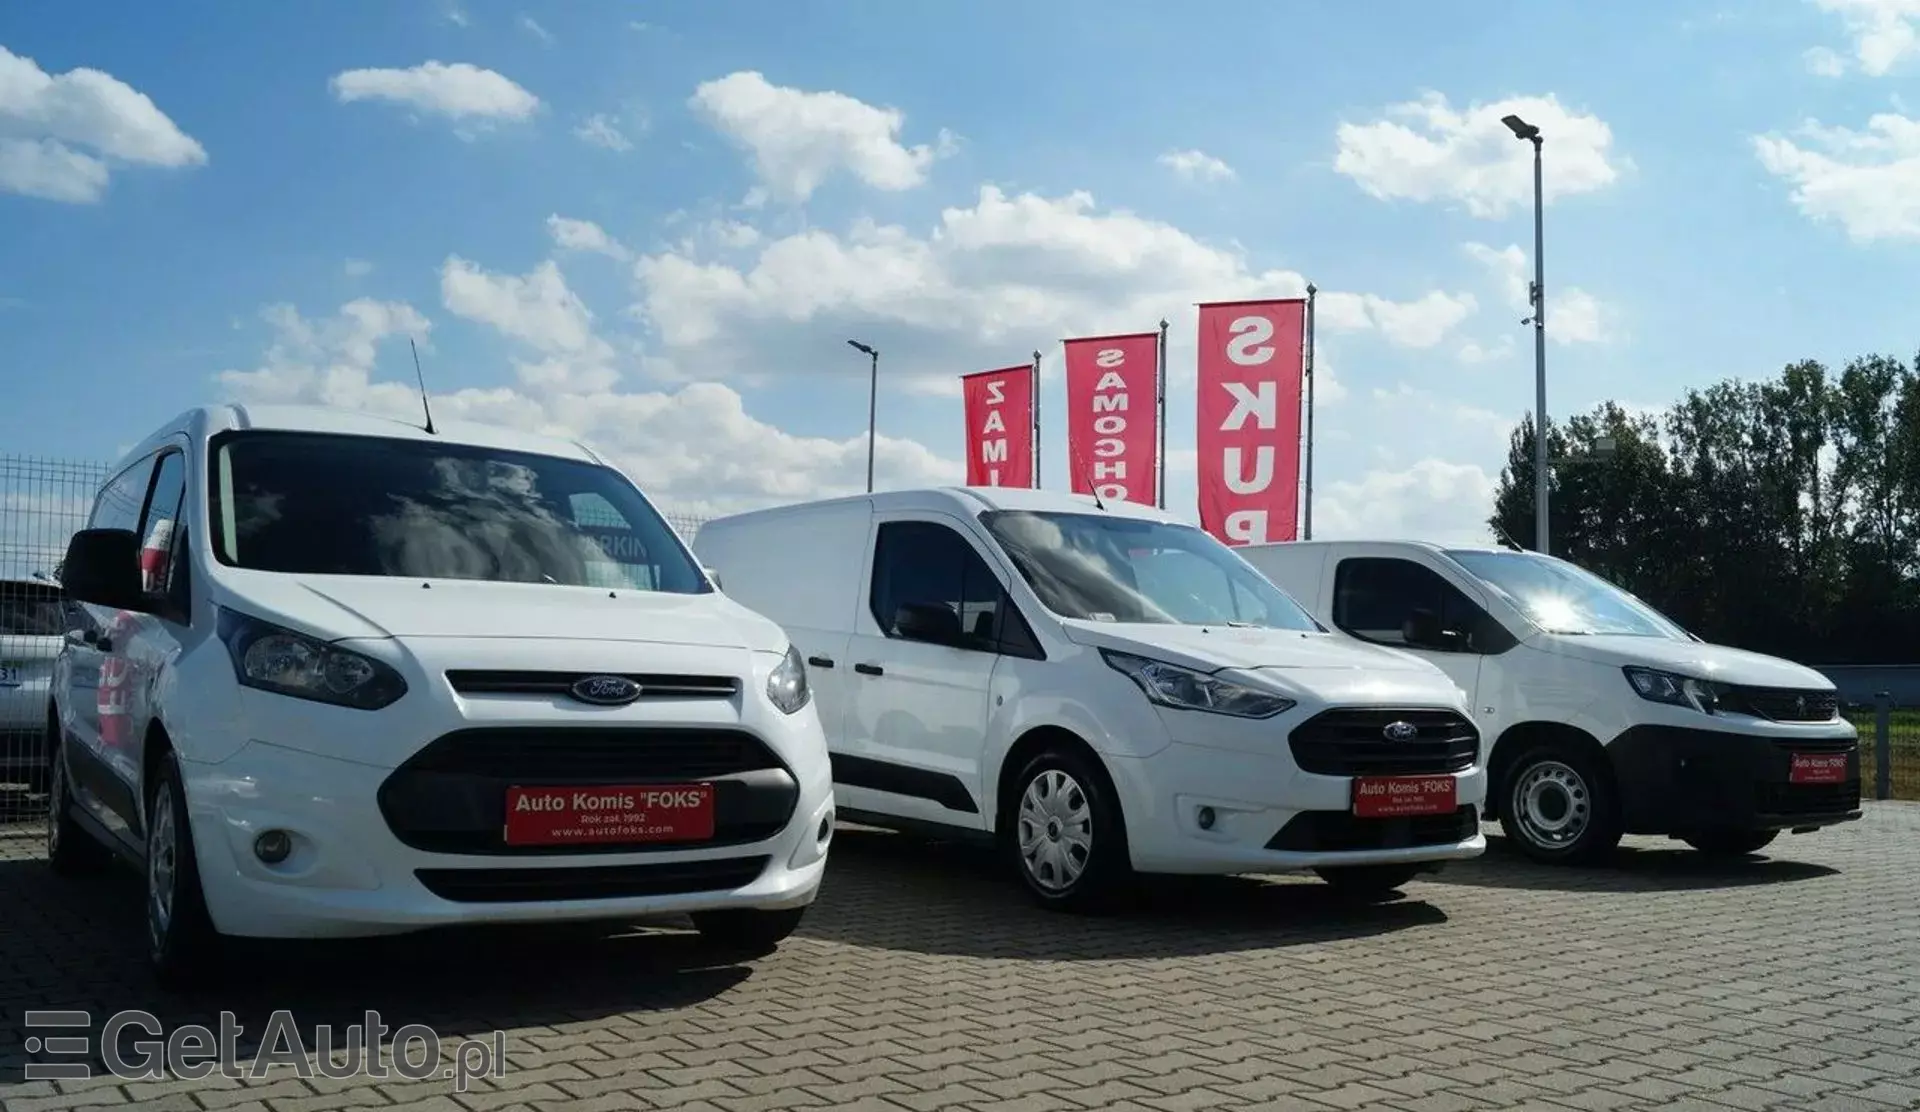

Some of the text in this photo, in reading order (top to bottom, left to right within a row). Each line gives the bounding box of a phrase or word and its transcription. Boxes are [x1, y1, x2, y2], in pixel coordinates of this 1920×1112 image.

[1360, 783, 1385, 795] Auto
[1388, 781, 1419, 794] Komis
[515, 791, 708, 811] Auto Komis "FOKS"
[581, 815, 601, 824] Rok
[623, 813, 646, 823] 1992
[551, 825, 674, 837] www.autofoks.com
